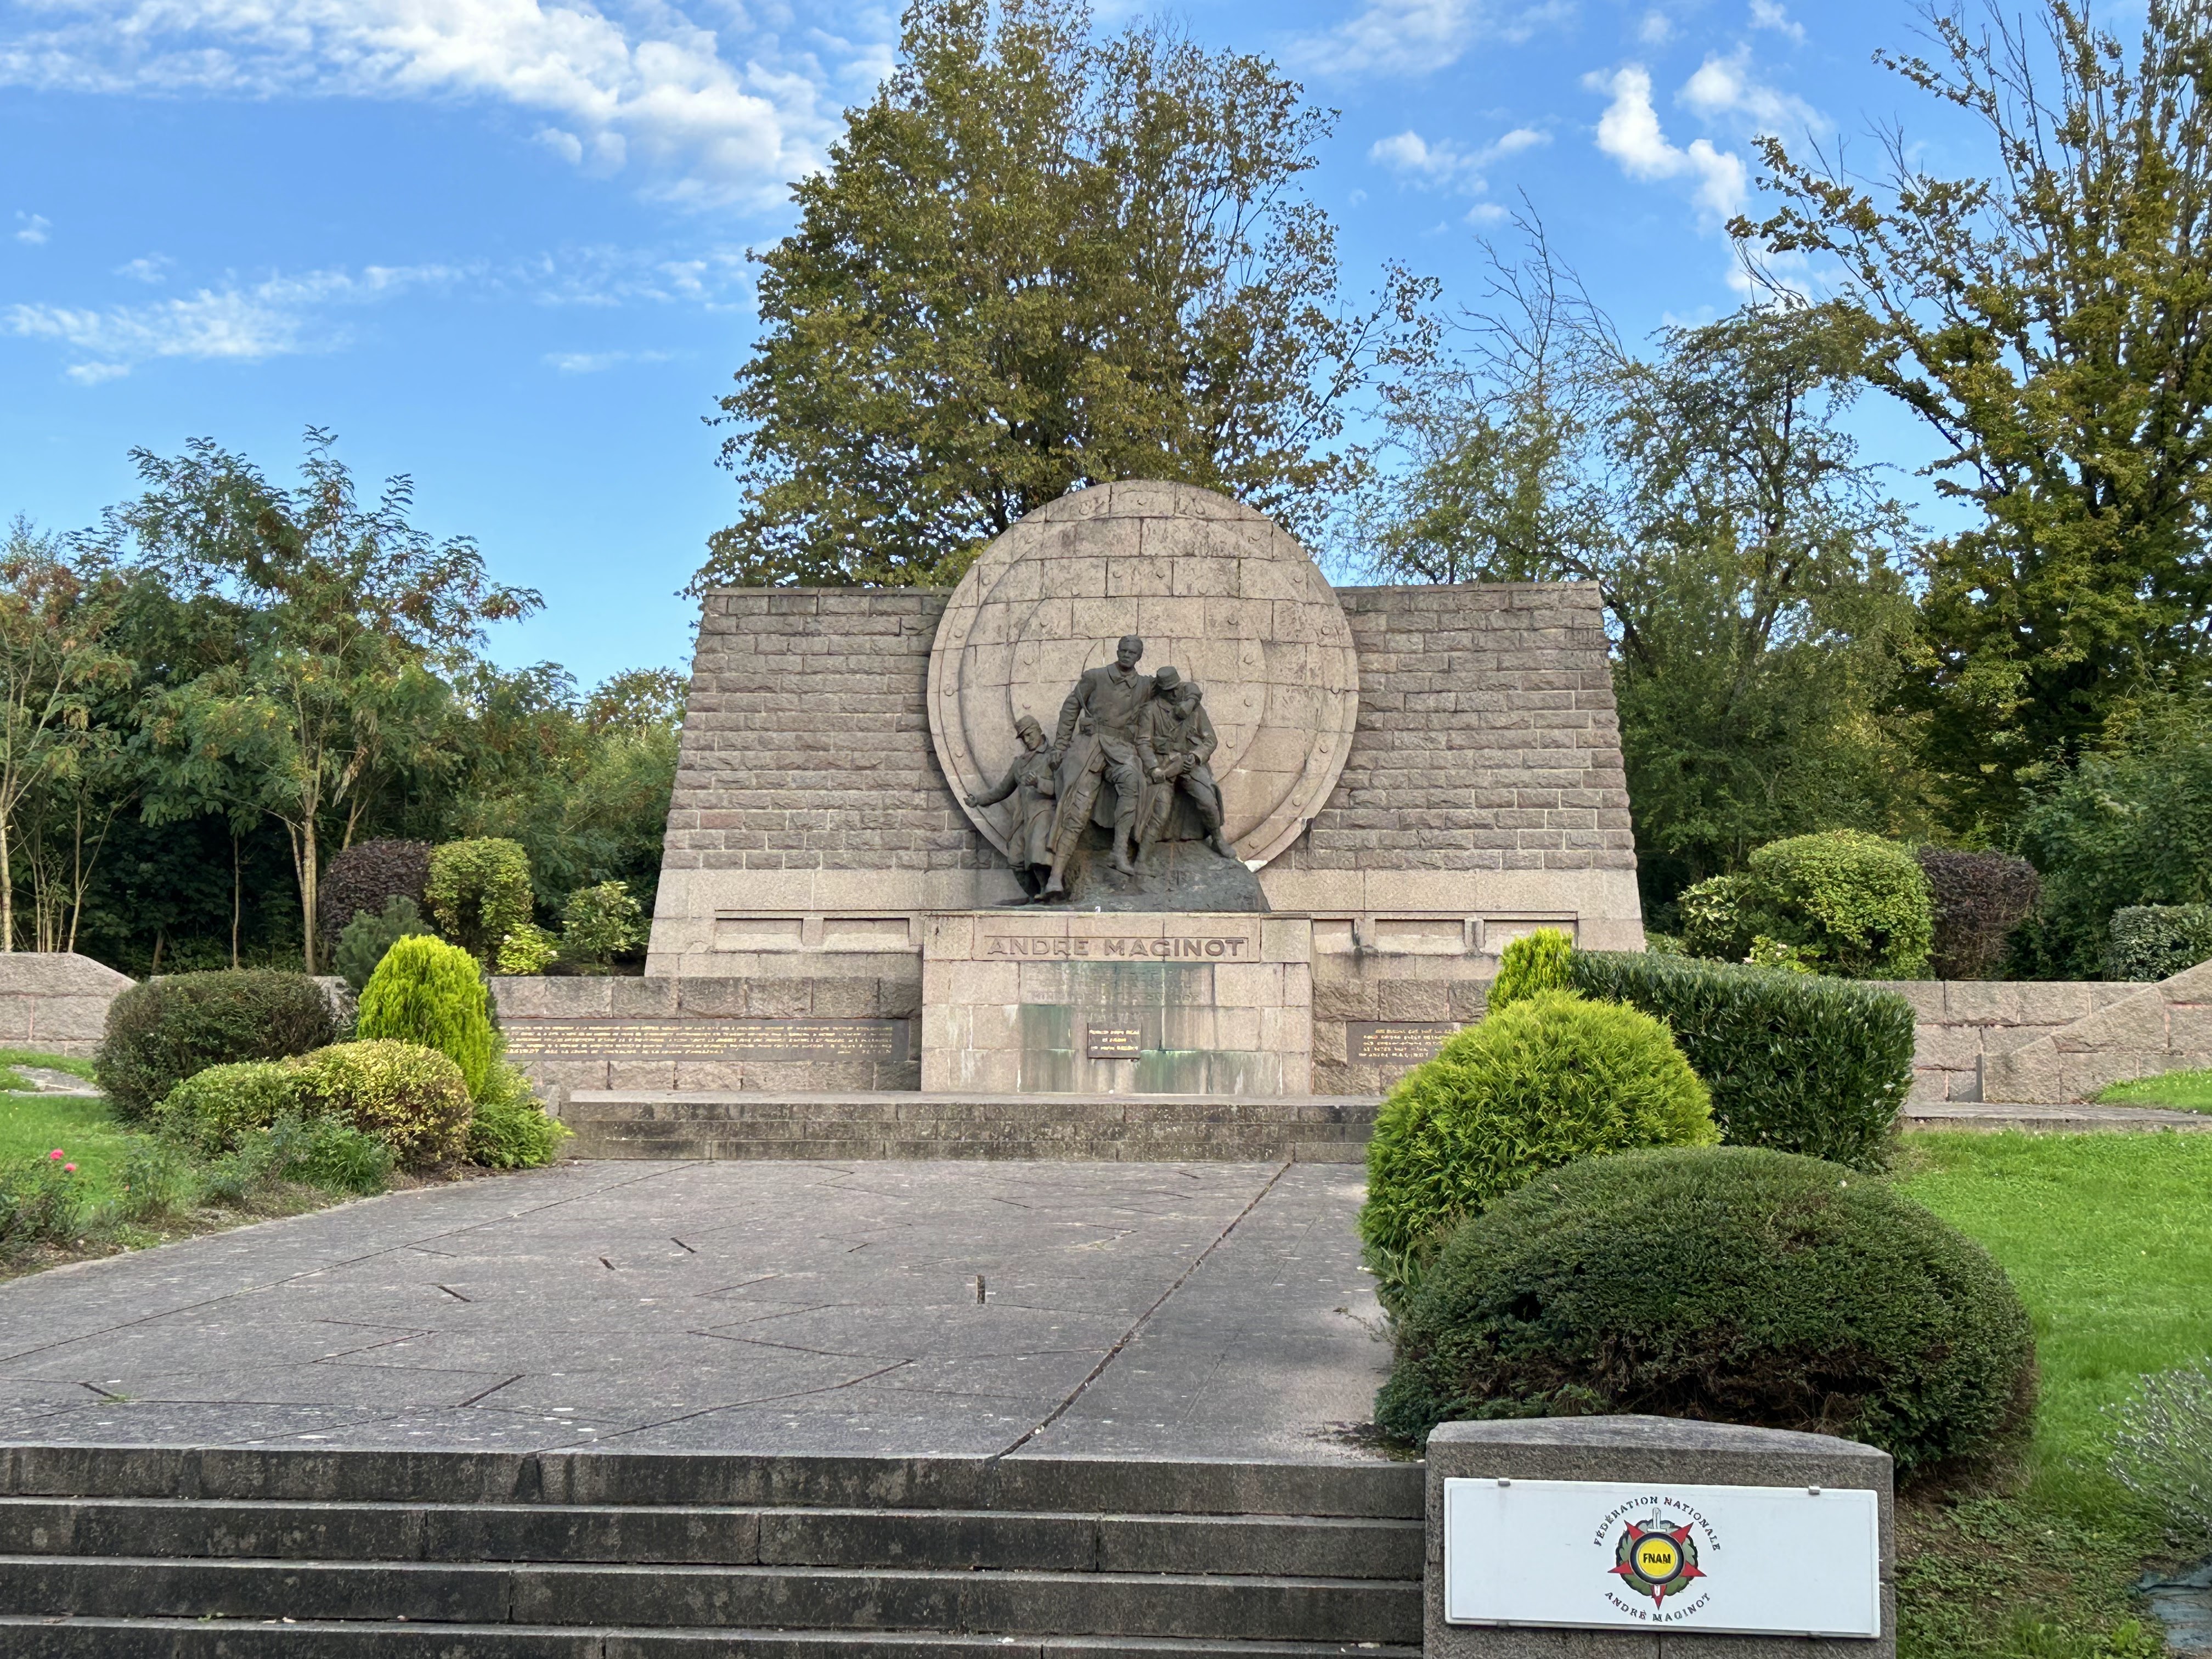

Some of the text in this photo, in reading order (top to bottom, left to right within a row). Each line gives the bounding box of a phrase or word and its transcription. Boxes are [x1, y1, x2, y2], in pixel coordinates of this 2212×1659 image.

[987, 938, 1244, 957] ANDRE MAGINOT
[1593, 1496, 1721, 1551] FÉDÉRATION NATIONALE
[1643, 1553, 1671, 1564] FNAM
[1605, 1592, 1711, 1622] ANDRÉ MAGINOT
